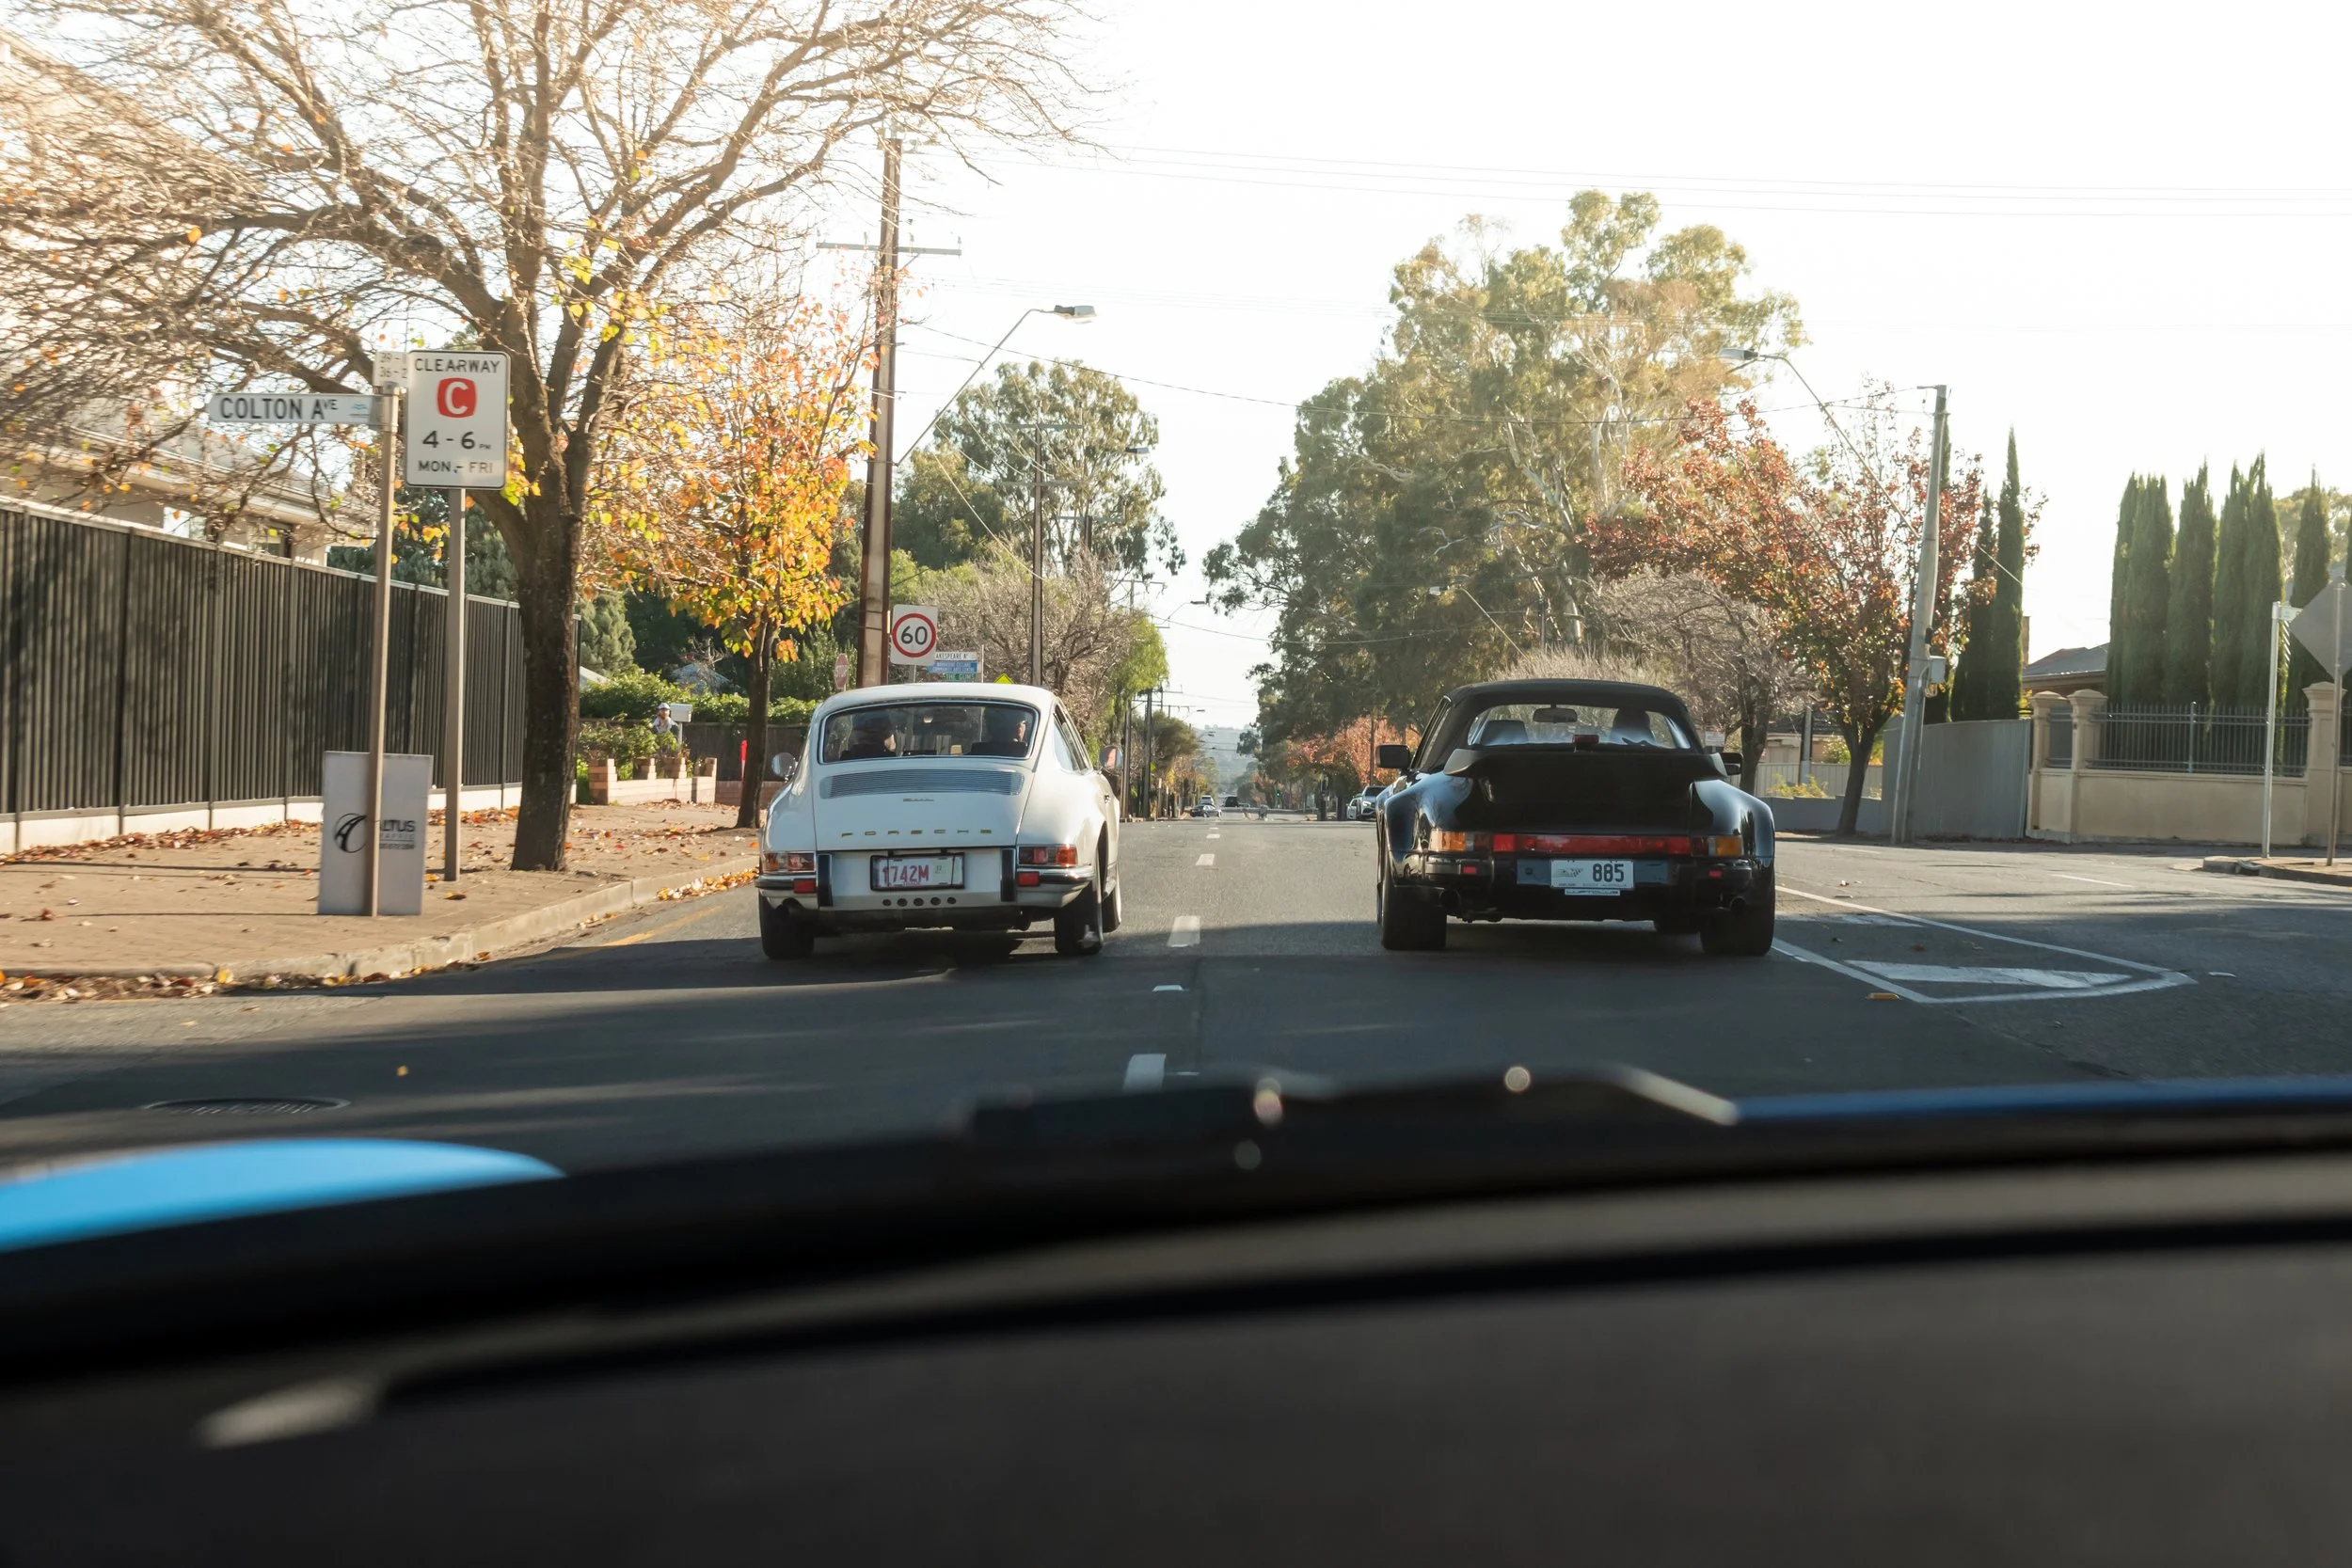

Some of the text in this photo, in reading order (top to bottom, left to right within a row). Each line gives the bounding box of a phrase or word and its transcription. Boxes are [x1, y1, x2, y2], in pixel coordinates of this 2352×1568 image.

[414, 357, 501, 373] CLEARWAY
[444, 381, 469, 415] C
[219, 397, 302, 420] COLTON
[422, 430, 439, 449] 4
[461, 431, 476, 450] 6
[469, 461, 494, 473] FRI
[900, 625, 929, 645] 60
[379, 819, 416, 832] LTUS
[882, 864, 930, 884] 1742M
[1592, 863, 1625, 882] 885
